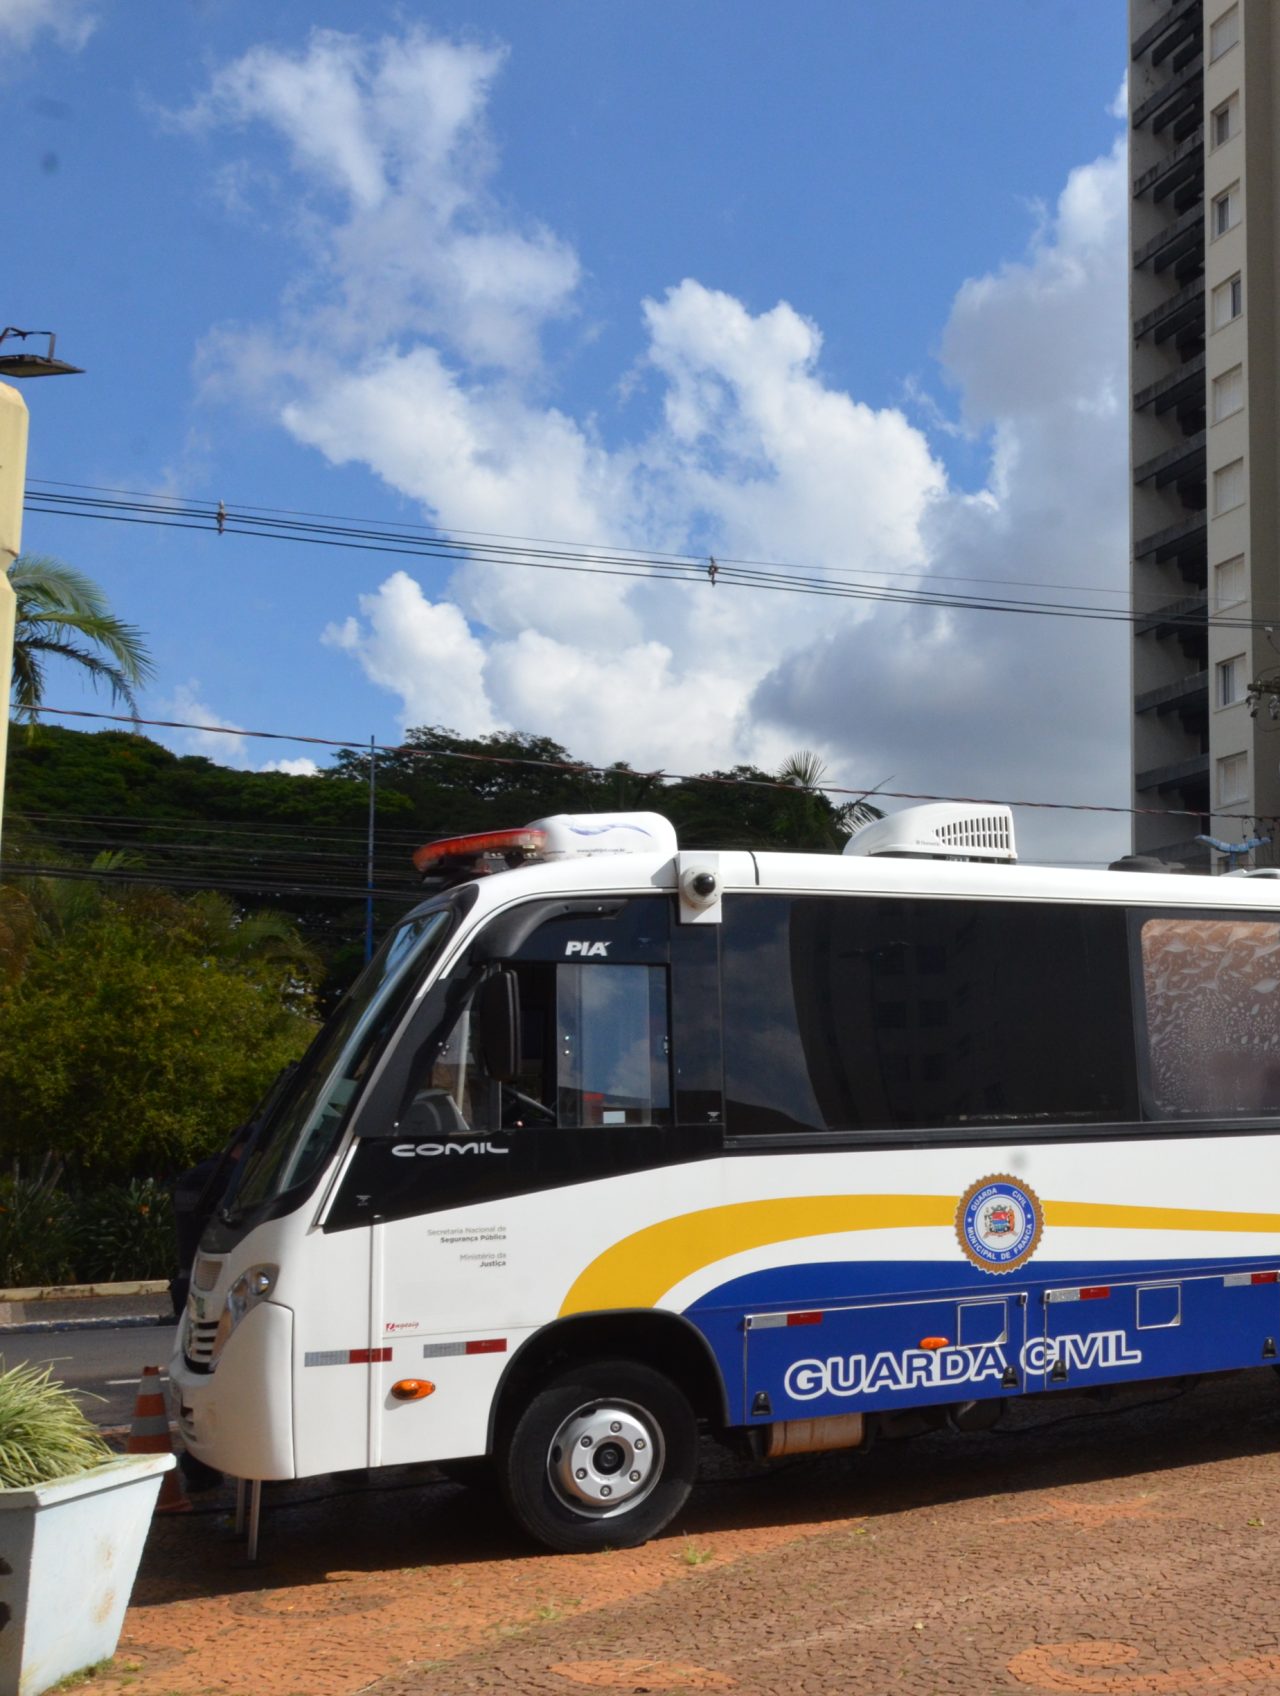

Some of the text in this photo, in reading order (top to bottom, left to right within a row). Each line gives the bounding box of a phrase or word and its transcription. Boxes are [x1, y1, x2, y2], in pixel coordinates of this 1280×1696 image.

[391, 1142, 509, 1157] COMIL
[971, 1187, 1027, 1211] GUARDA CIVIL
[427, 1227, 463, 1236] Secretaria
[465, 1226, 495, 1234] Nacional
[440, 1233, 507, 1244] Segurança Pública
[967, 1223, 1033, 1260] MUNICIPAL DE FRANCA
[460, 1252, 495, 1260] Ministério
[479, 1260, 507, 1268] Justiça
[784, 1330, 1142, 1400] GUARDA CIVIL
